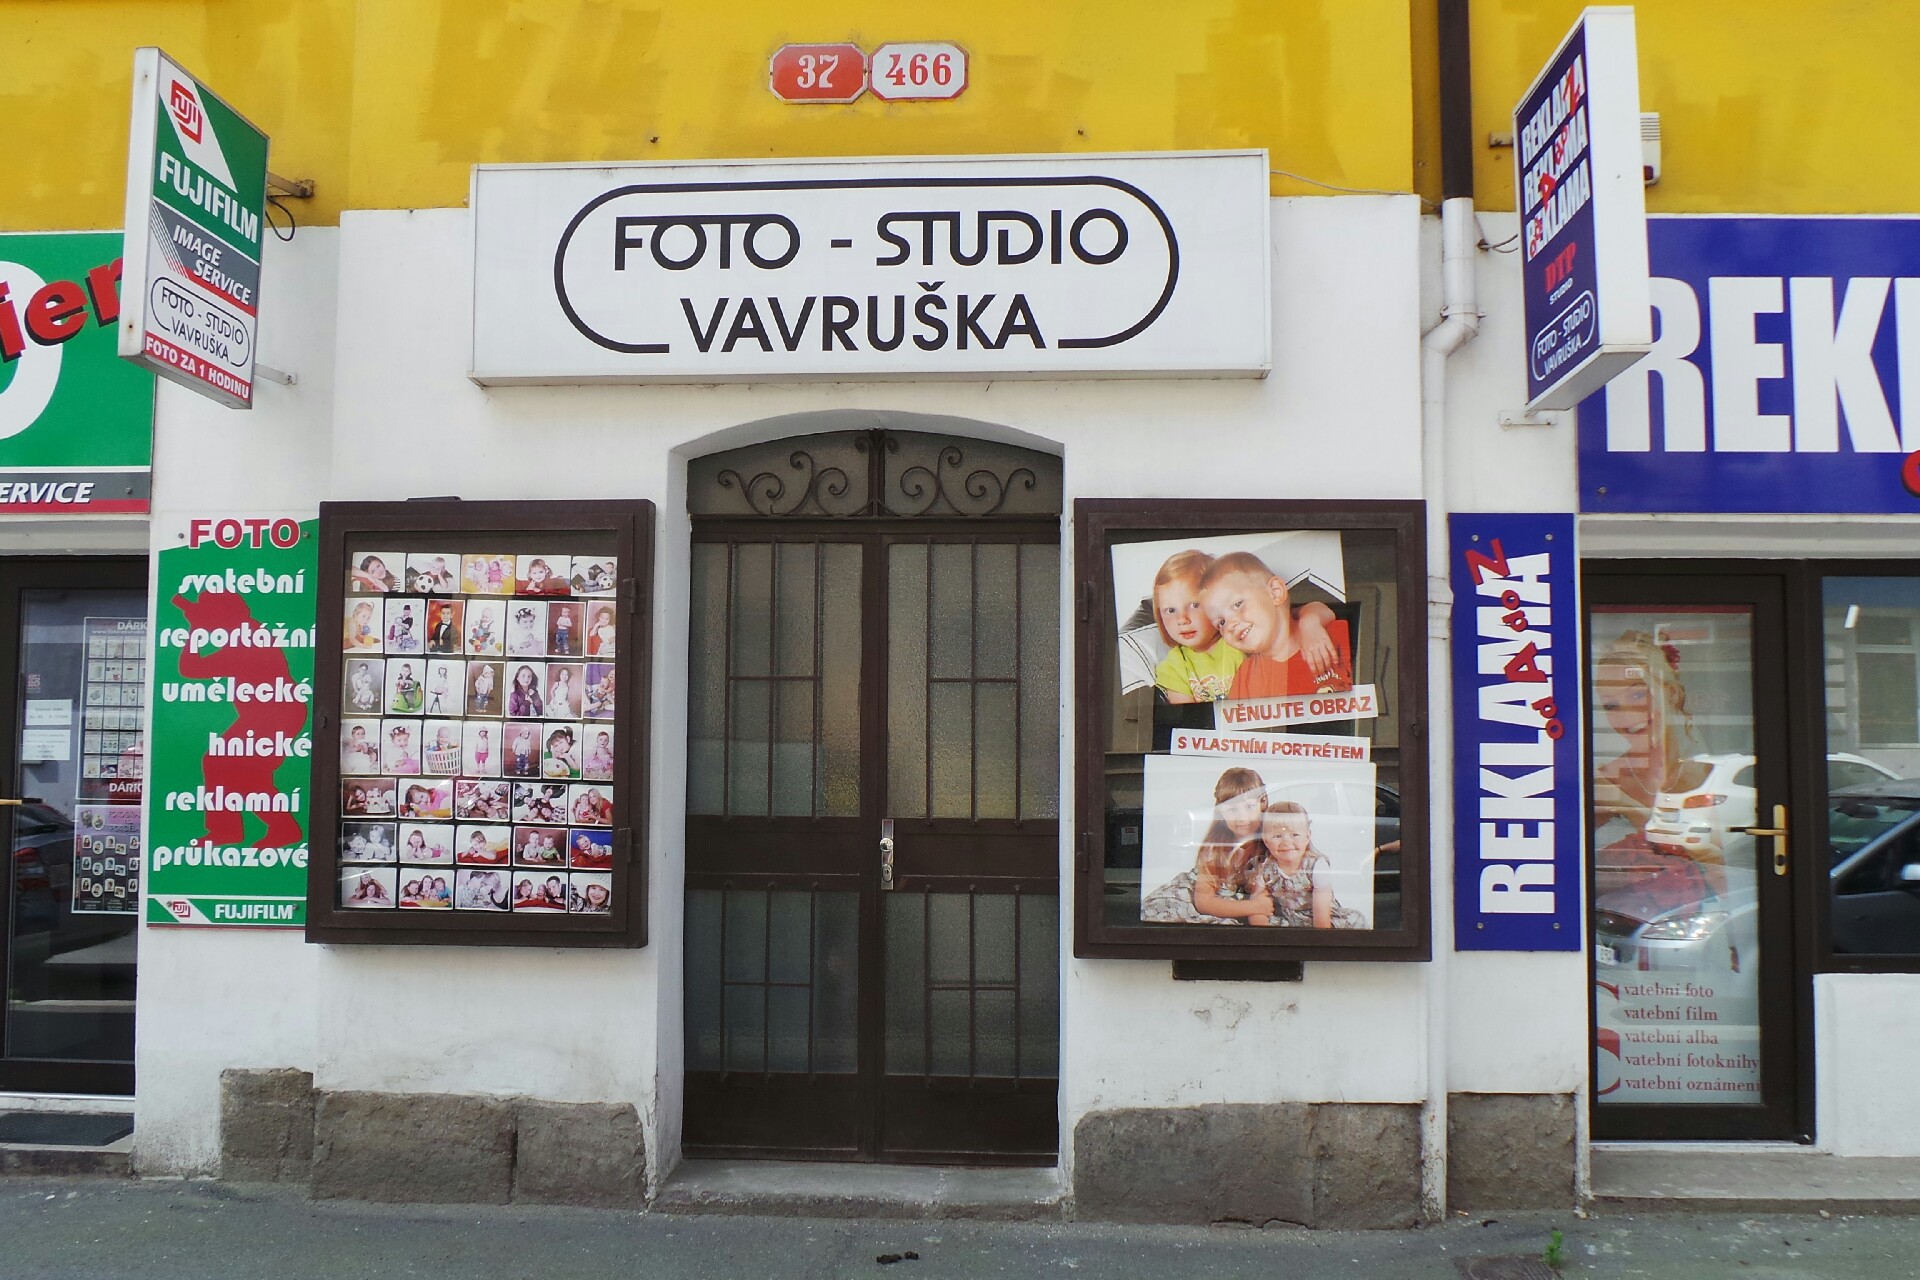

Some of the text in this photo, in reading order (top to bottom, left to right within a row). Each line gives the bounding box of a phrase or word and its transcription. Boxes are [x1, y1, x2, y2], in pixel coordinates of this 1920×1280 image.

[797, 54, 839, 88] 37
[885, 53, 952, 86] 466
[160, 151, 258, 243] FUJIFILM
[173, 225, 222, 266] IMAGE
[615, 214, 800, 271] FOTO
[876, 208, 1128, 266] STUDIO
[193, 260, 252, 305] SERVICE
[1545, 242, 1577, 293] DTP
[161, 286, 194, 318] FOTO
[205, 312, 244, 345] STUDIO
[680, 281, 1046, 352] VAVRUŠKA
[1538, 329, 1558, 359] FOTO
[1563, 299, 1590, 338] STUDIO
[172, 317, 229, 363] VAVRUŠKA
[1543, 333, 1582, 376] VAVRUŠKA
[146, 336, 249, 399] FOTO ZA 1 HODINU
[188, 518, 300, 549] FOTO
[178, 568, 306, 594] svatební
[159, 622, 316, 653] reportážní
[162, 677, 312, 702] umělecké
[1223, 695, 1372, 724] VĚNUJTE OBRAZ
[209, 729, 312, 757] hnické
[1178, 736, 1364, 760] S VLASTNÍM PORTRÉTEM
[1476, 552, 1555, 914] REKLAMA
[165, 785, 301, 812] reklamní
[153, 838, 309, 871] průkazové
[215, 904, 293, 919] FUJIFILM
[1624, 982, 1714, 998] vatební foto
[1624, 1005, 1718, 1021] vatební film
[1625, 1028, 1719, 1044] vatební alba
[1625, 1051, 1759, 1073] vatební fotoknihy
[1625, 1075, 1681, 1090] vatební
